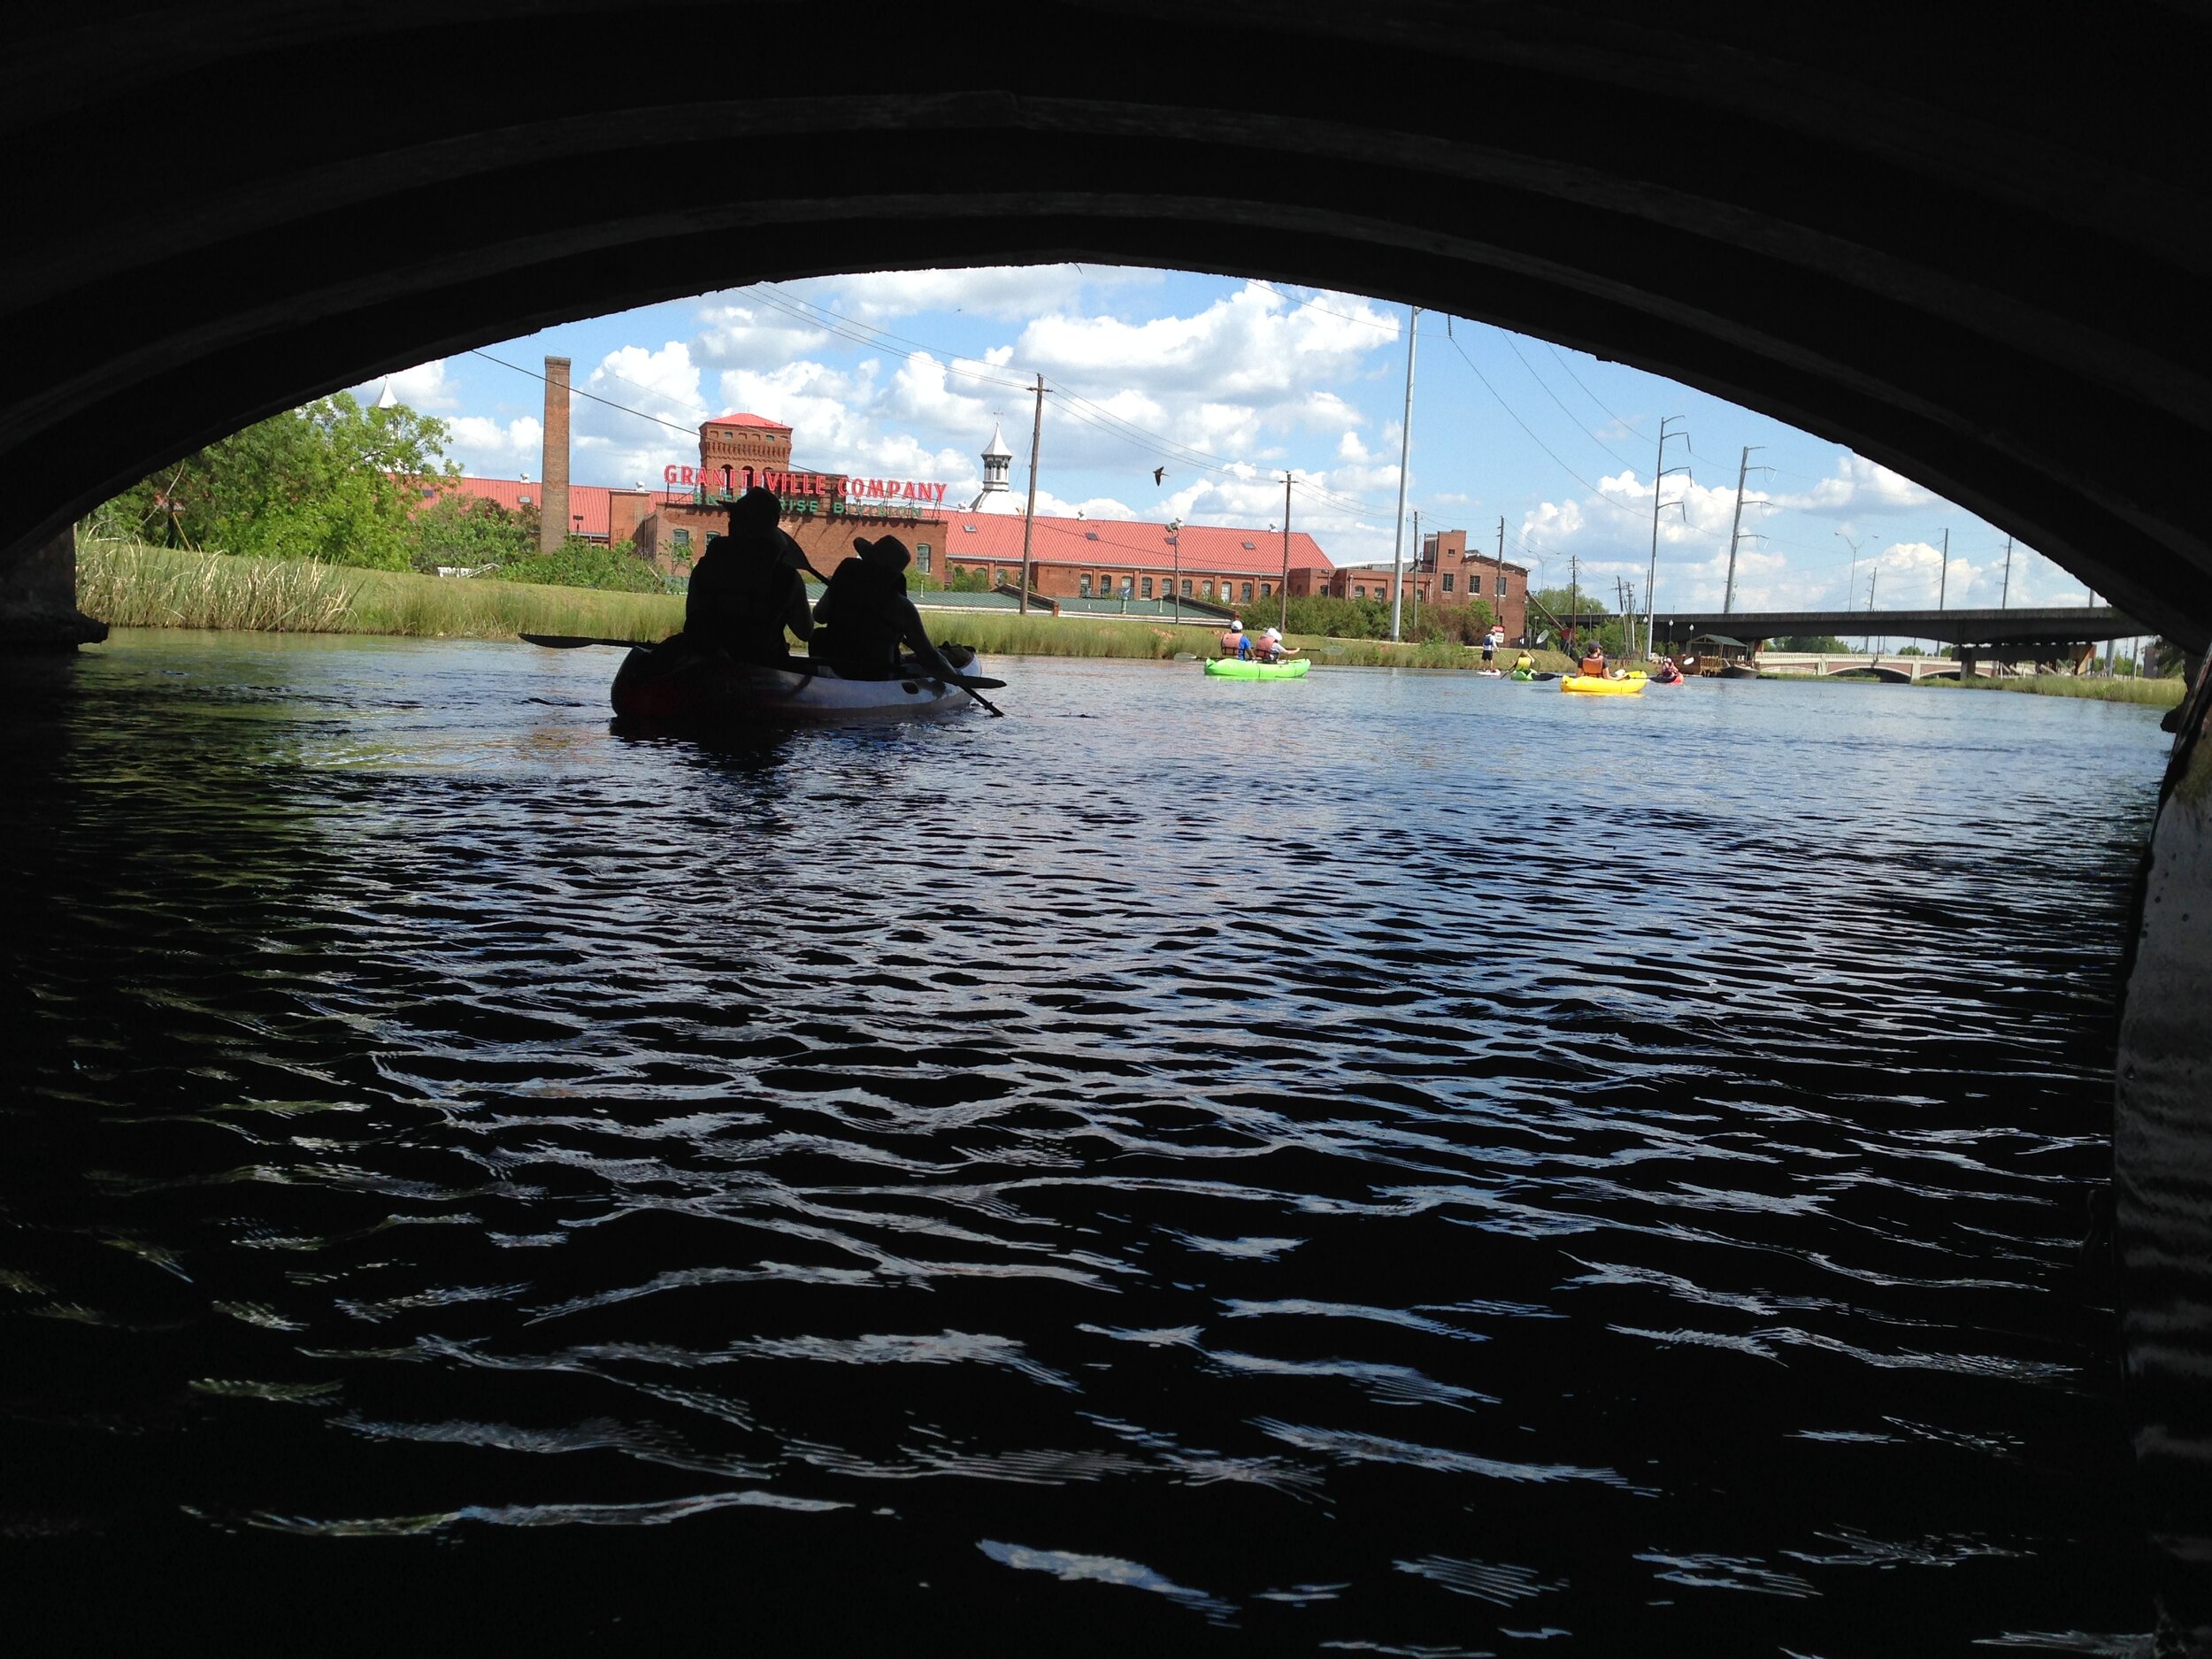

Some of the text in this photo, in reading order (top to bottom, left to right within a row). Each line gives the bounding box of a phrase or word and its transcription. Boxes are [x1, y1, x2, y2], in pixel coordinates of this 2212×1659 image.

[664, 464, 947, 502] GRANITEVILLE COMPANY
[694, 492, 922, 518] ENTRISE DIVISION
